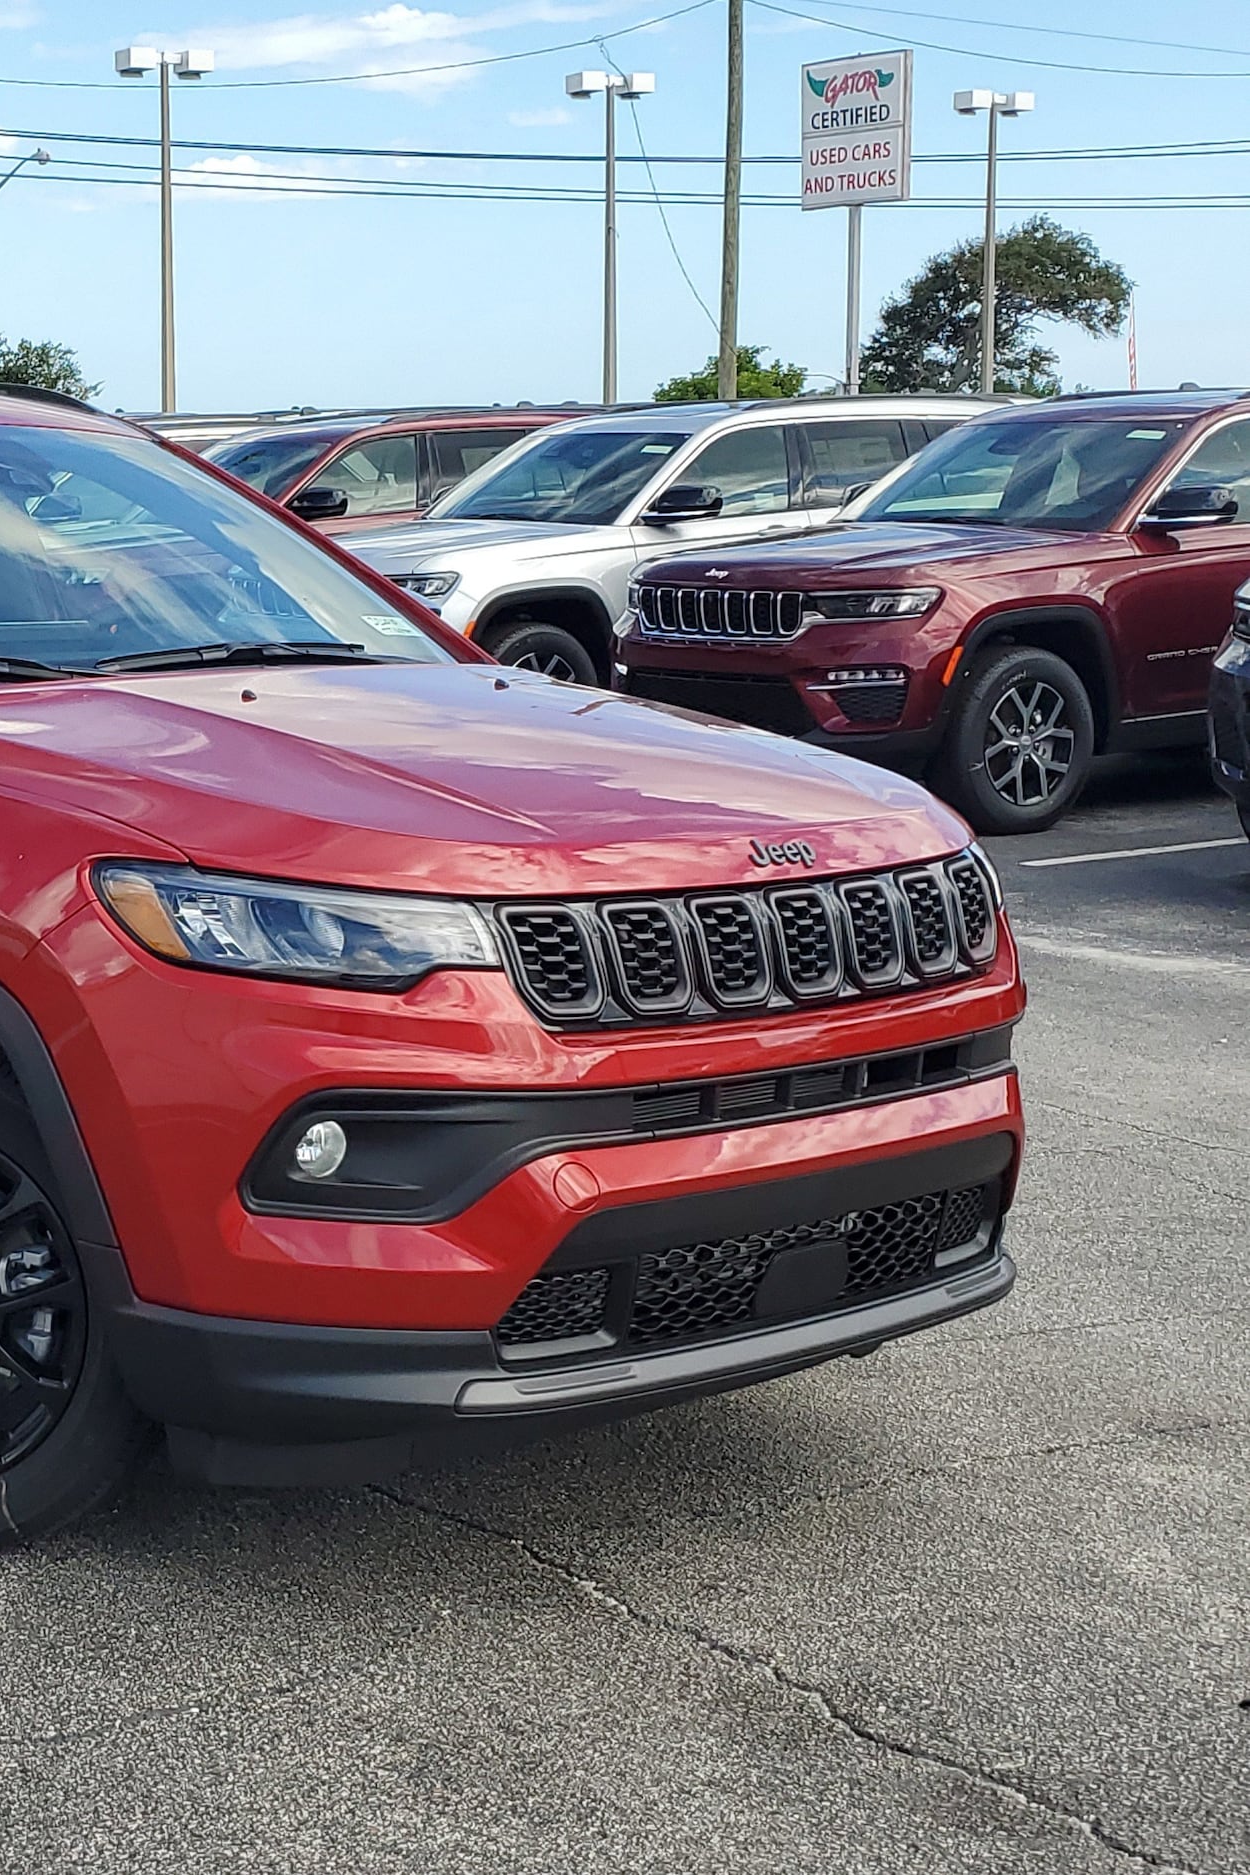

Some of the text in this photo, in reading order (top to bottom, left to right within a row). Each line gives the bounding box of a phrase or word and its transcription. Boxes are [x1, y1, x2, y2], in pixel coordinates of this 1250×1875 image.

[824, 69, 880, 108] GATOR
[811, 103, 891, 130] CERTIFIED
[809, 141, 891, 166] USED CARS
[804, 169, 897, 194] AND TRUCKS
[748, 837, 817, 869] Jeep
